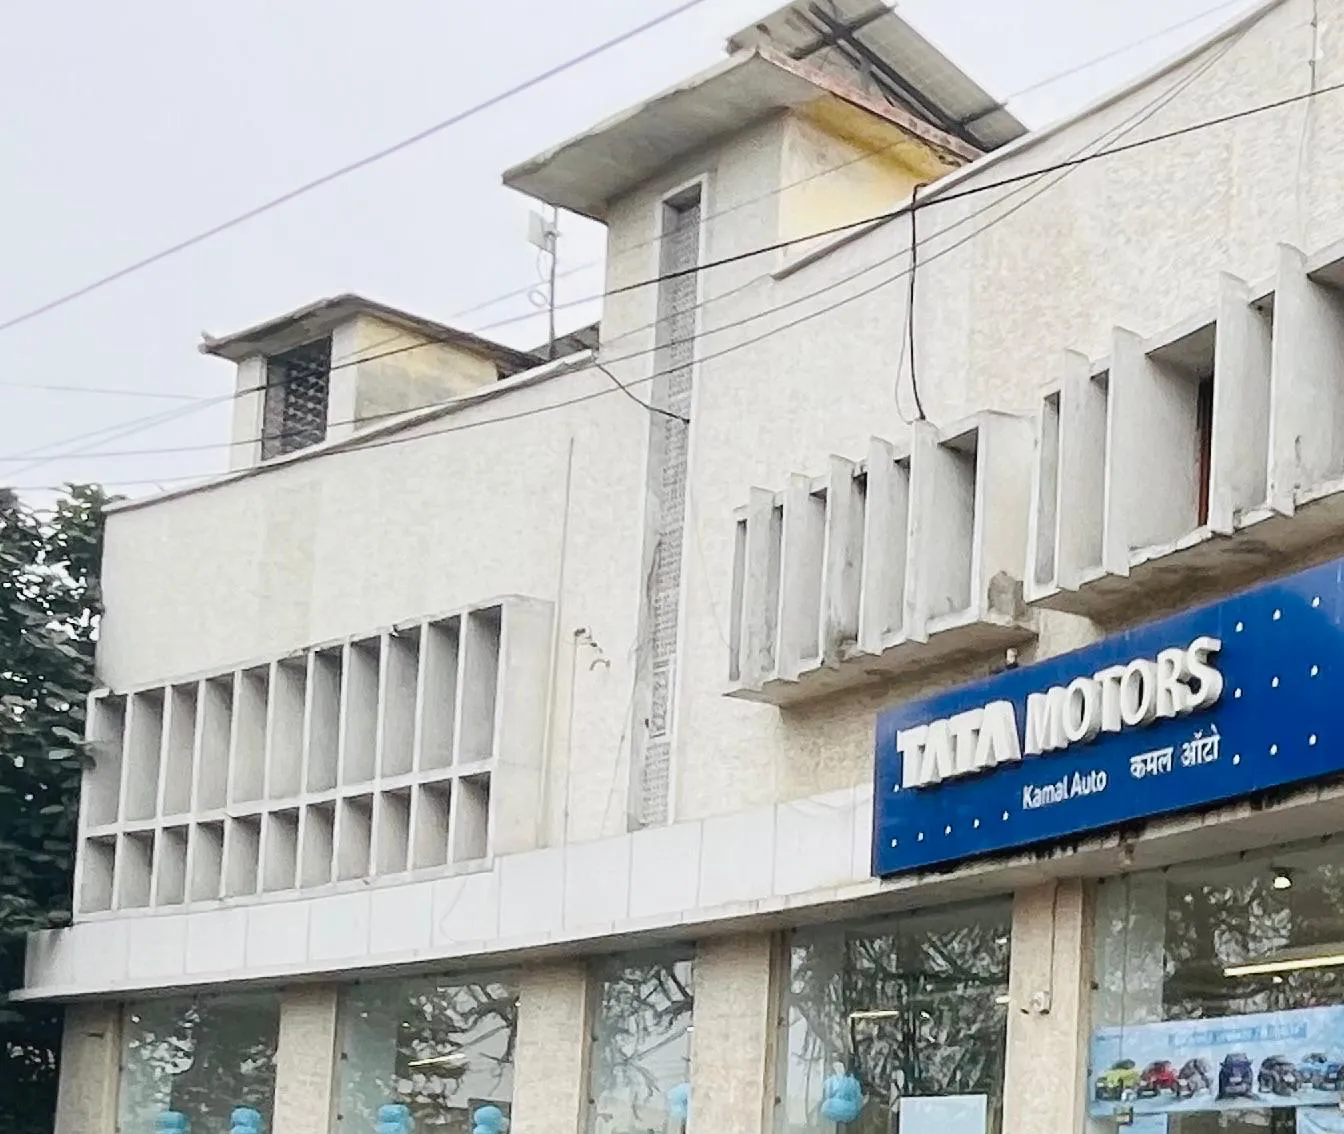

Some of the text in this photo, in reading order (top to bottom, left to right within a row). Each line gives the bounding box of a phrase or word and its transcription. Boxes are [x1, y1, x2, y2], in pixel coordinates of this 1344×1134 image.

[897, 636, 1223, 788] TATA MOTORS
[1130, 723, 1221, 780] कमल ऑटो
[1023, 768, 1108, 810] Kamal Auto
